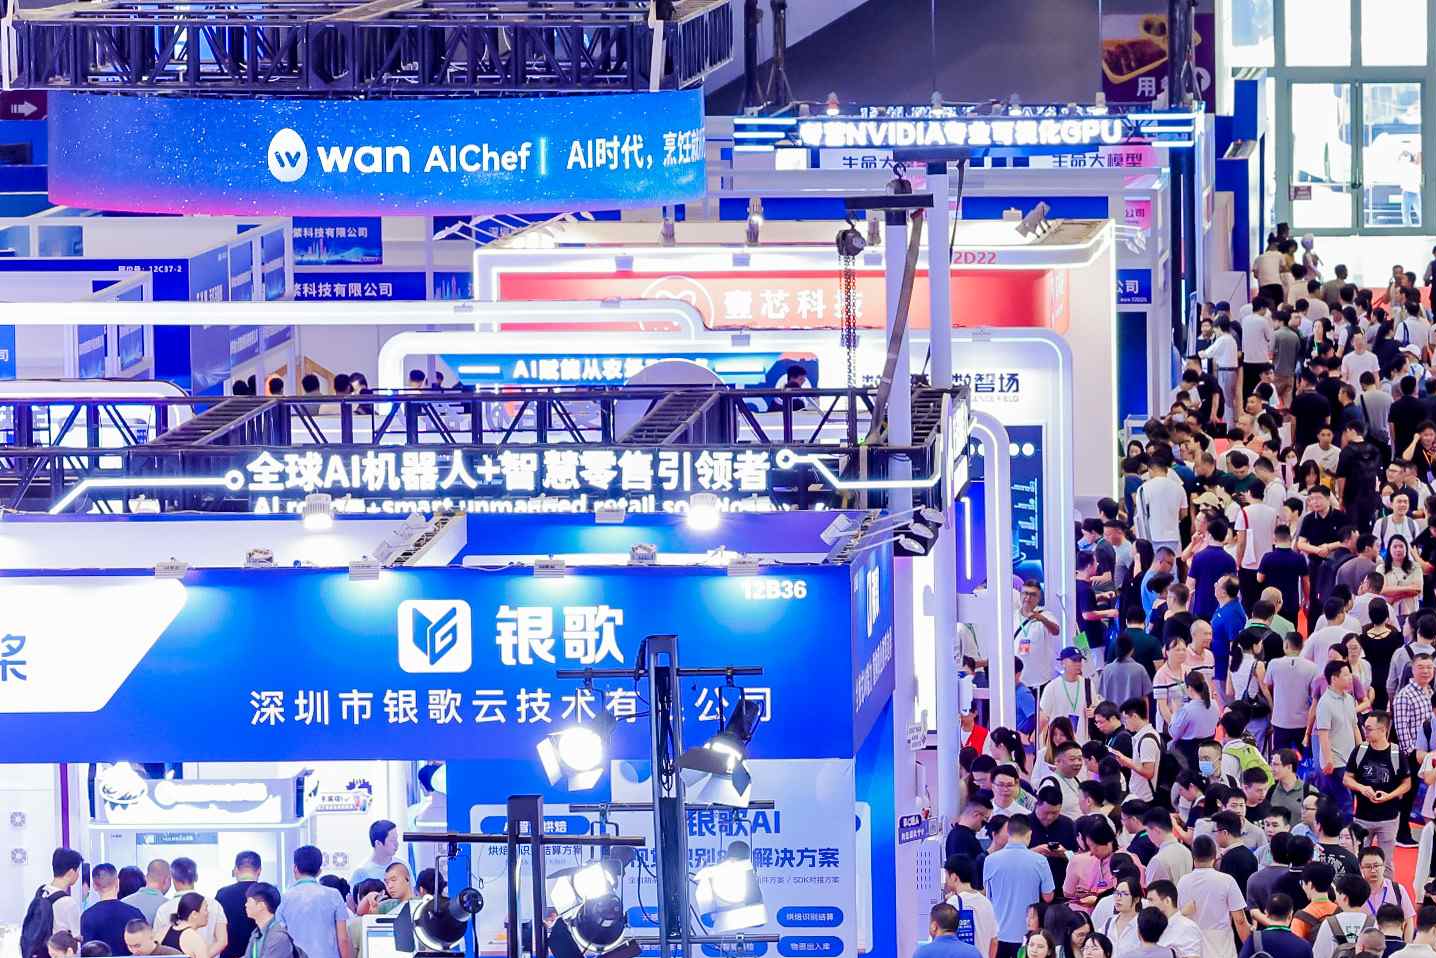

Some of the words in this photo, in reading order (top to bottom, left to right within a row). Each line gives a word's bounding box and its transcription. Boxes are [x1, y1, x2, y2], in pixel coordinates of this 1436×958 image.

[318, 144, 410, 174] wan
[424, 142, 530, 172] AIChef
[247, 449, 771, 492] 全球AI机器人+智慧零售引领者
[495, 604, 626, 666] 银歌
